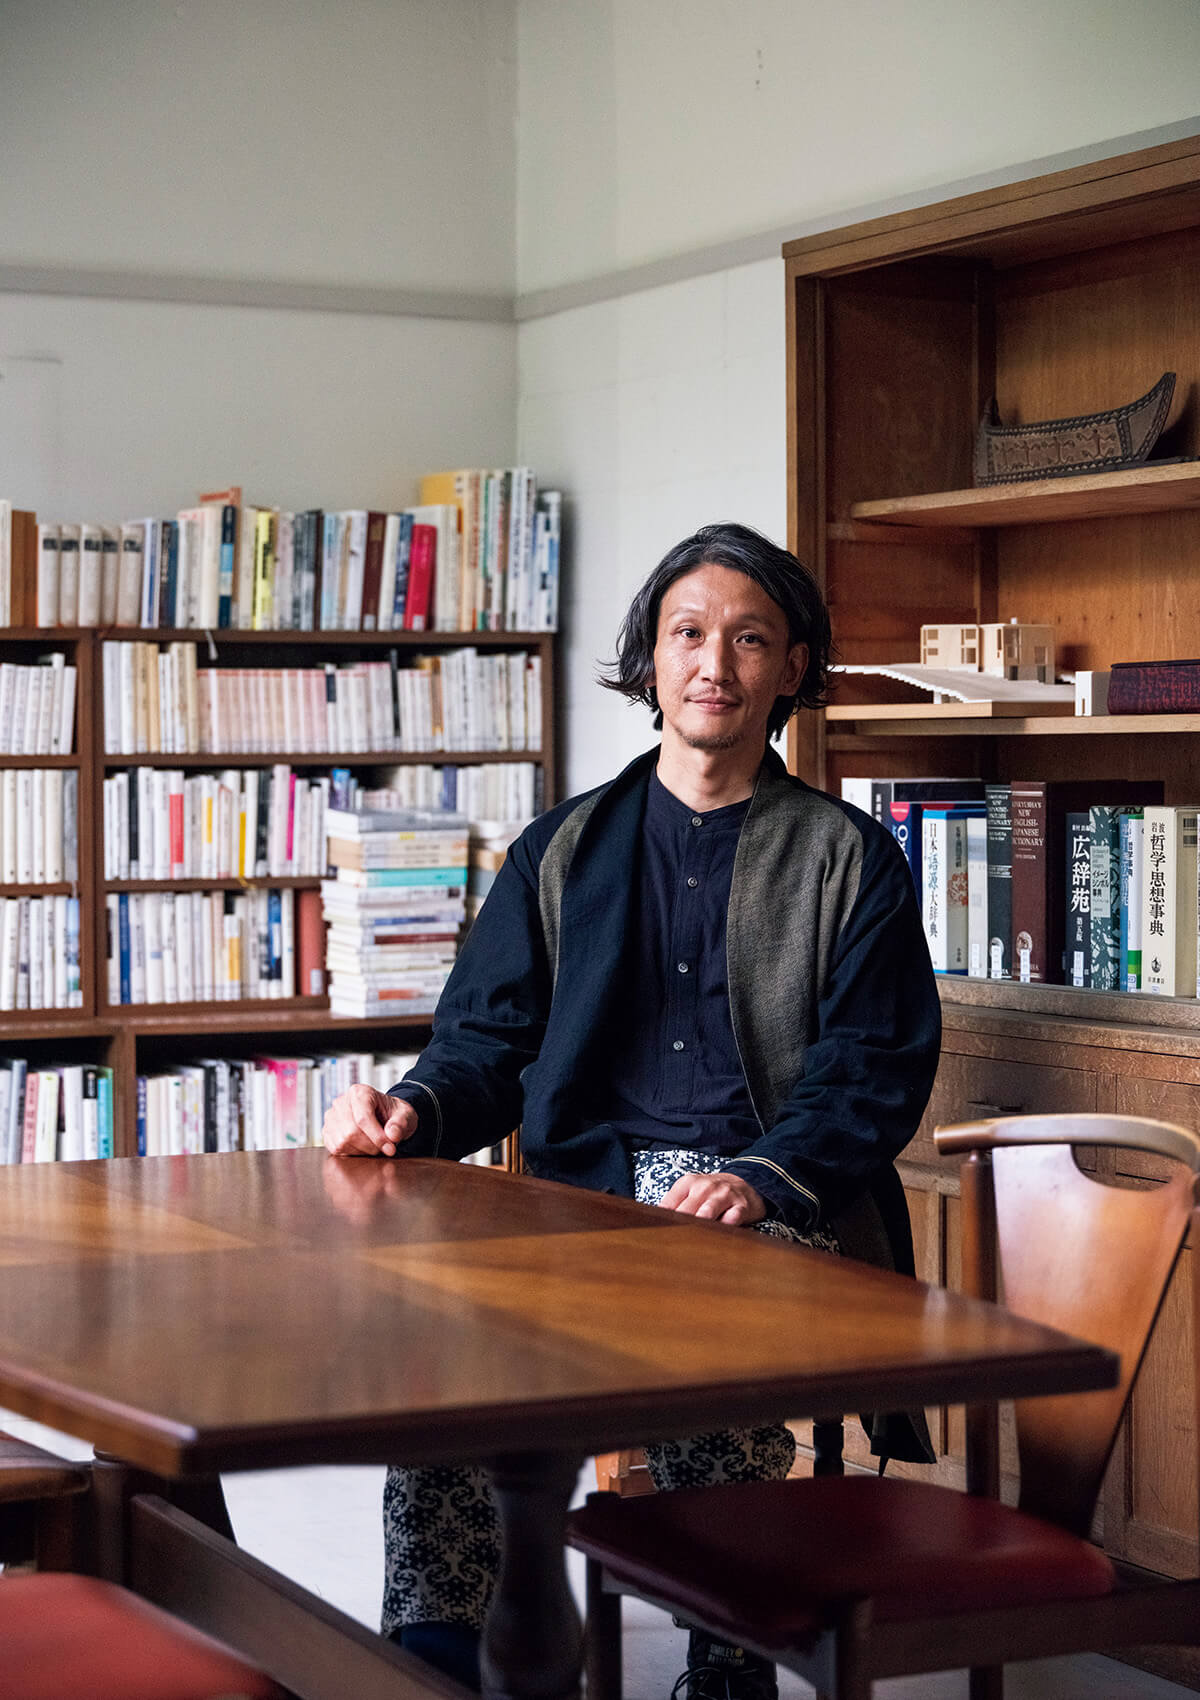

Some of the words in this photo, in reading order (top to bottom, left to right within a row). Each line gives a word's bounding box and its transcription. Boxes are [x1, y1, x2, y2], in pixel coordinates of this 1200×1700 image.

[1018, 809, 1031, 817] NEW
[1070, 835, 1091, 913] 広辞苑
